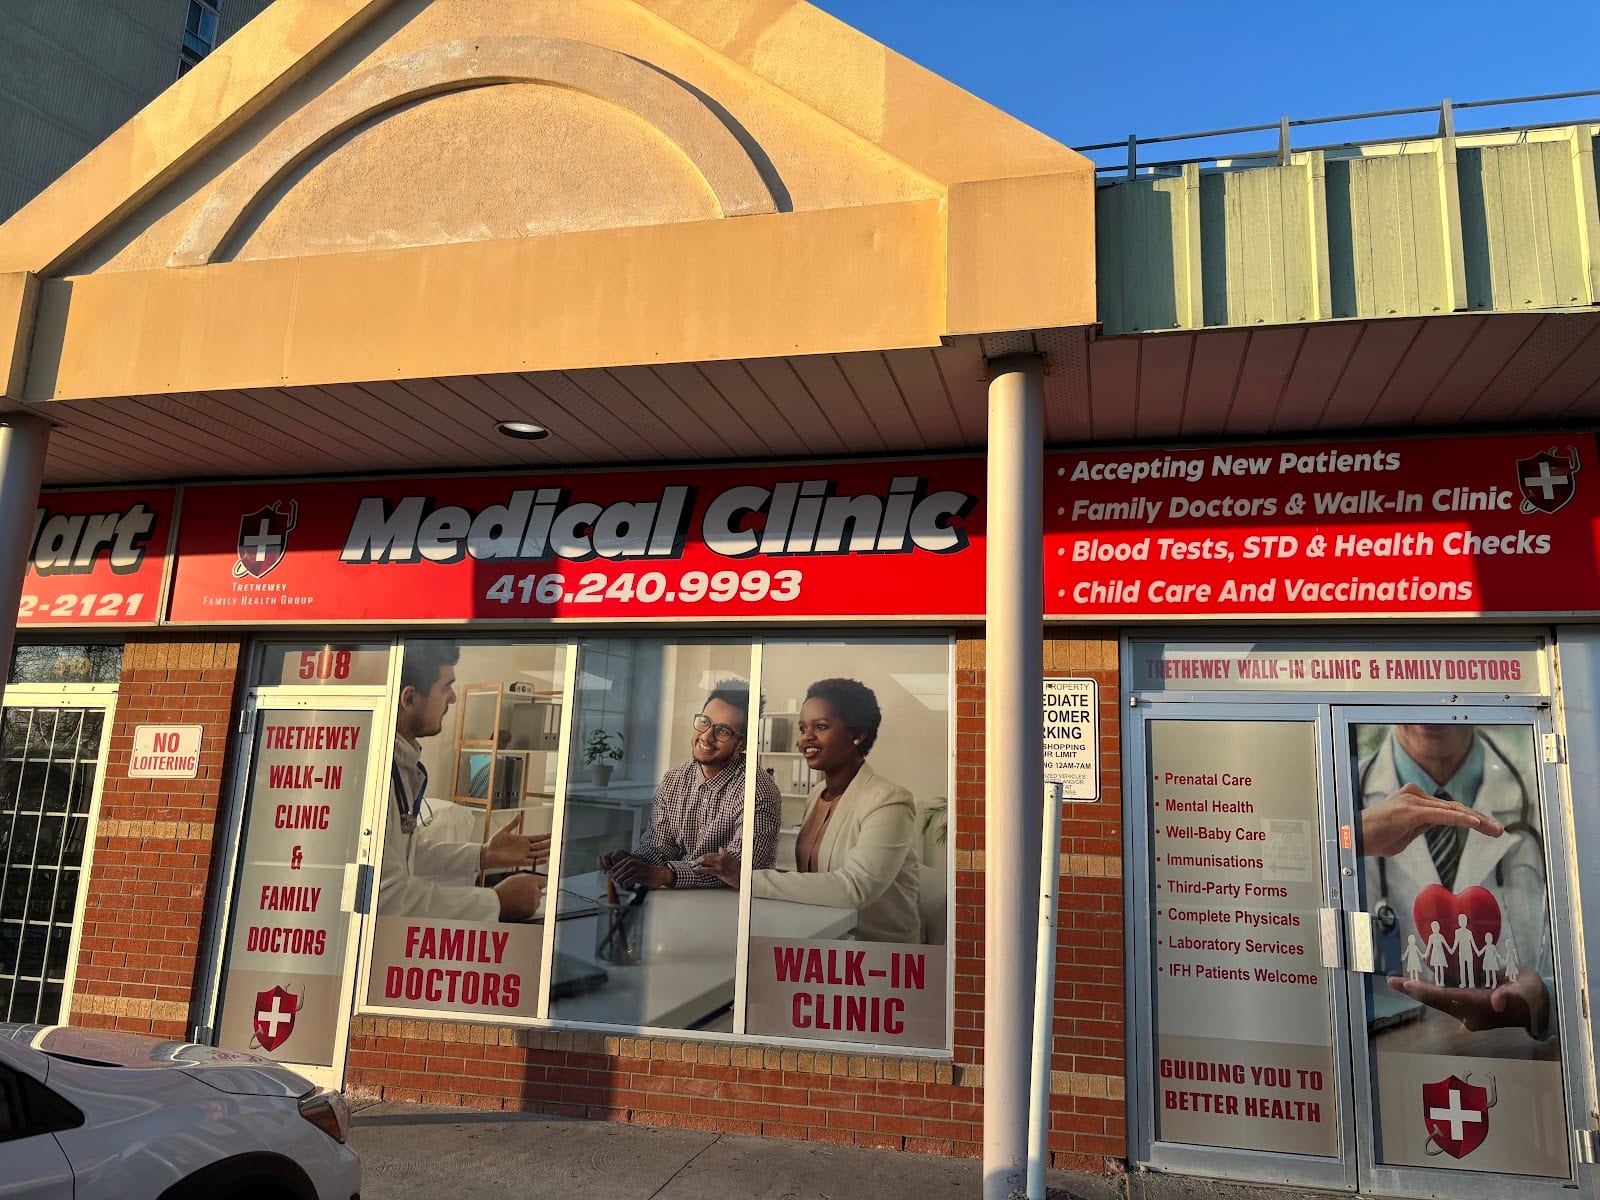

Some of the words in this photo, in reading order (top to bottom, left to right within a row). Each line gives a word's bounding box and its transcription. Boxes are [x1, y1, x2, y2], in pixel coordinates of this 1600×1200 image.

[1071, 457, 1204, 484] Accepting
[1212, 453, 1272, 476] New
[1278, 449, 1401, 475] Patients
[1072, 496, 1161, 523] Family
[1169, 493, 1277, 519] Doctors
[1285, 492, 1305, 515] &
[1314, 489, 1423, 514] Walk-In
[1432, 486, 1514, 512] Clinic
[338, 484, 696, 563] Medical
[701, 476, 971, 558] Clinic
[1071, 537, 1150, 562] Blood
[1157, 536, 1235, 564] Tests,
[1242, 535, 1299, 559] STD
[1306, 534, 1328, 559] &
[1335, 531, 1434, 557] Health
[1443, 529, 1551, 555] Checks
[485, 569, 803, 604] 416.240.9993
[1072, 580, 1140, 604] Child
[1148, 579, 1210, 604] Care
[1218, 577, 1276, 602] And
[1284, 576, 1473, 603] Vaccinations
[18, 592, 145, 617] 2-2121
[299, 651, 351, 680] 508
[1146, 659, 1231, 680] TRETHEWEY
[1237, 659, 1305, 680] WALK-IN
[1311, 659, 1362, 680] CLINIC
[1369, 659, 1380, 679] &
[1386, 659, 1442, 681] FAMILY
[1445, 659, 1522, 681] DOCTORS
[1046, 683, 1090, 691] PROPERTY
[152, 732, 180, 753] NO
[266, 726, 360, 750] TRETHEWEY
[1043, 726, 1082, 739] KING
[133, 755, 196, 771] LOITERING
[269, 765, 343, 790] WALK-IN
[1165, 773, 1218, 786] Prenatal
[1222, 774, 1252, 787] Care
[274, 804, 331, 830] CLINIC
[1165, 799, 1208, 812] Mental
[1212, 800, 1254, 813] Health
[1166, 826, 1231, 843] Well-Baby
[1235, 828, 1266, 841] Care
[290, 845, 303, 870] &
[1167, 853, 1264, 869] Immunisations
[259, 885, 322, 912] FAMILY
[1167, 880, 1240, 898] Third-Party
[1245, 883, 1288, 897] Forms
[1168, 908, 1231, 925] Complete
[1235, 910, 1300, 927] Physicals
[246, 926, 327, 955] DOCTORS
[404, 926, 510, 965] FAMILY
[1169, 936, 1241, 954] Laboratory
[1245, 939, 1304, 955] Services
[773, 946, 925, 990] WALK-IN
[1169, 963, 1191, 977] IFH
[1196, 965, 1250, 980] Patients
[1254, 968, 1318, 985] Welcome
[384, 966, 522, 1008] DOCTORS
[791, 992, 906, 1035] CLINIC
[1160, 1058, 1246, 1085] GUIDING
[1251, 1065, 1291, 1090] YOU
[1296, 1069, 1323, 1091] TO
[1165, 1090, 1239, 1116] BETTER
[1245, 1096, 1321, 1123] HEALTH
